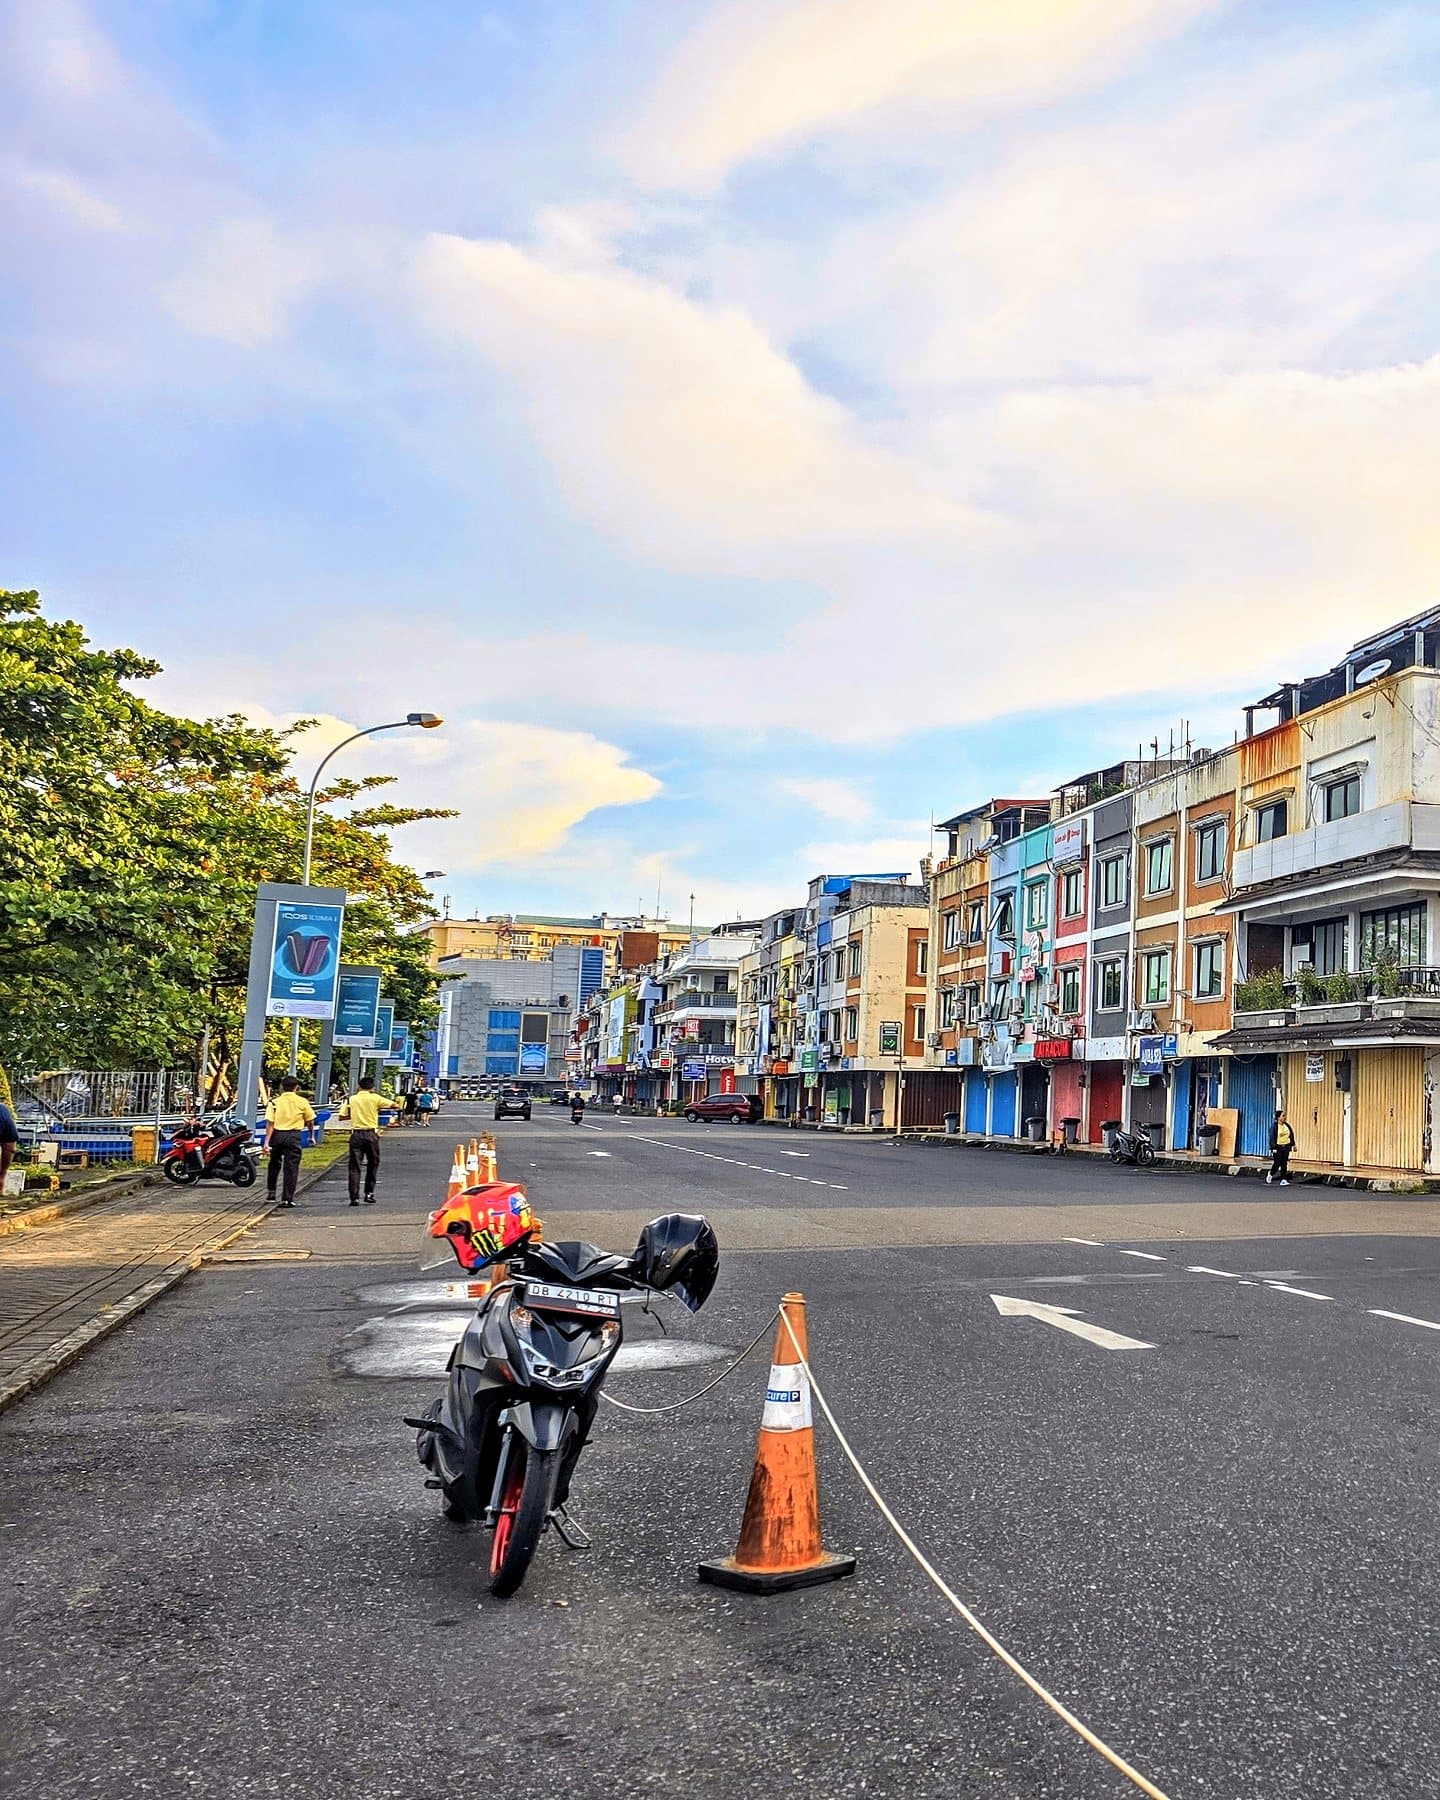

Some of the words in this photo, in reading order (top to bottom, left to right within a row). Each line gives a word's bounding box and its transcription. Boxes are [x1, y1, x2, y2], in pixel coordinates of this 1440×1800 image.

[282, 912, 307, 920] IQOS
[1166, 1035, 1175, 1047] P
[532, 1285, 549, 1296] DB
[598, 1294, 613, 1305] RT
[791, 1391, 799, 1401] P
